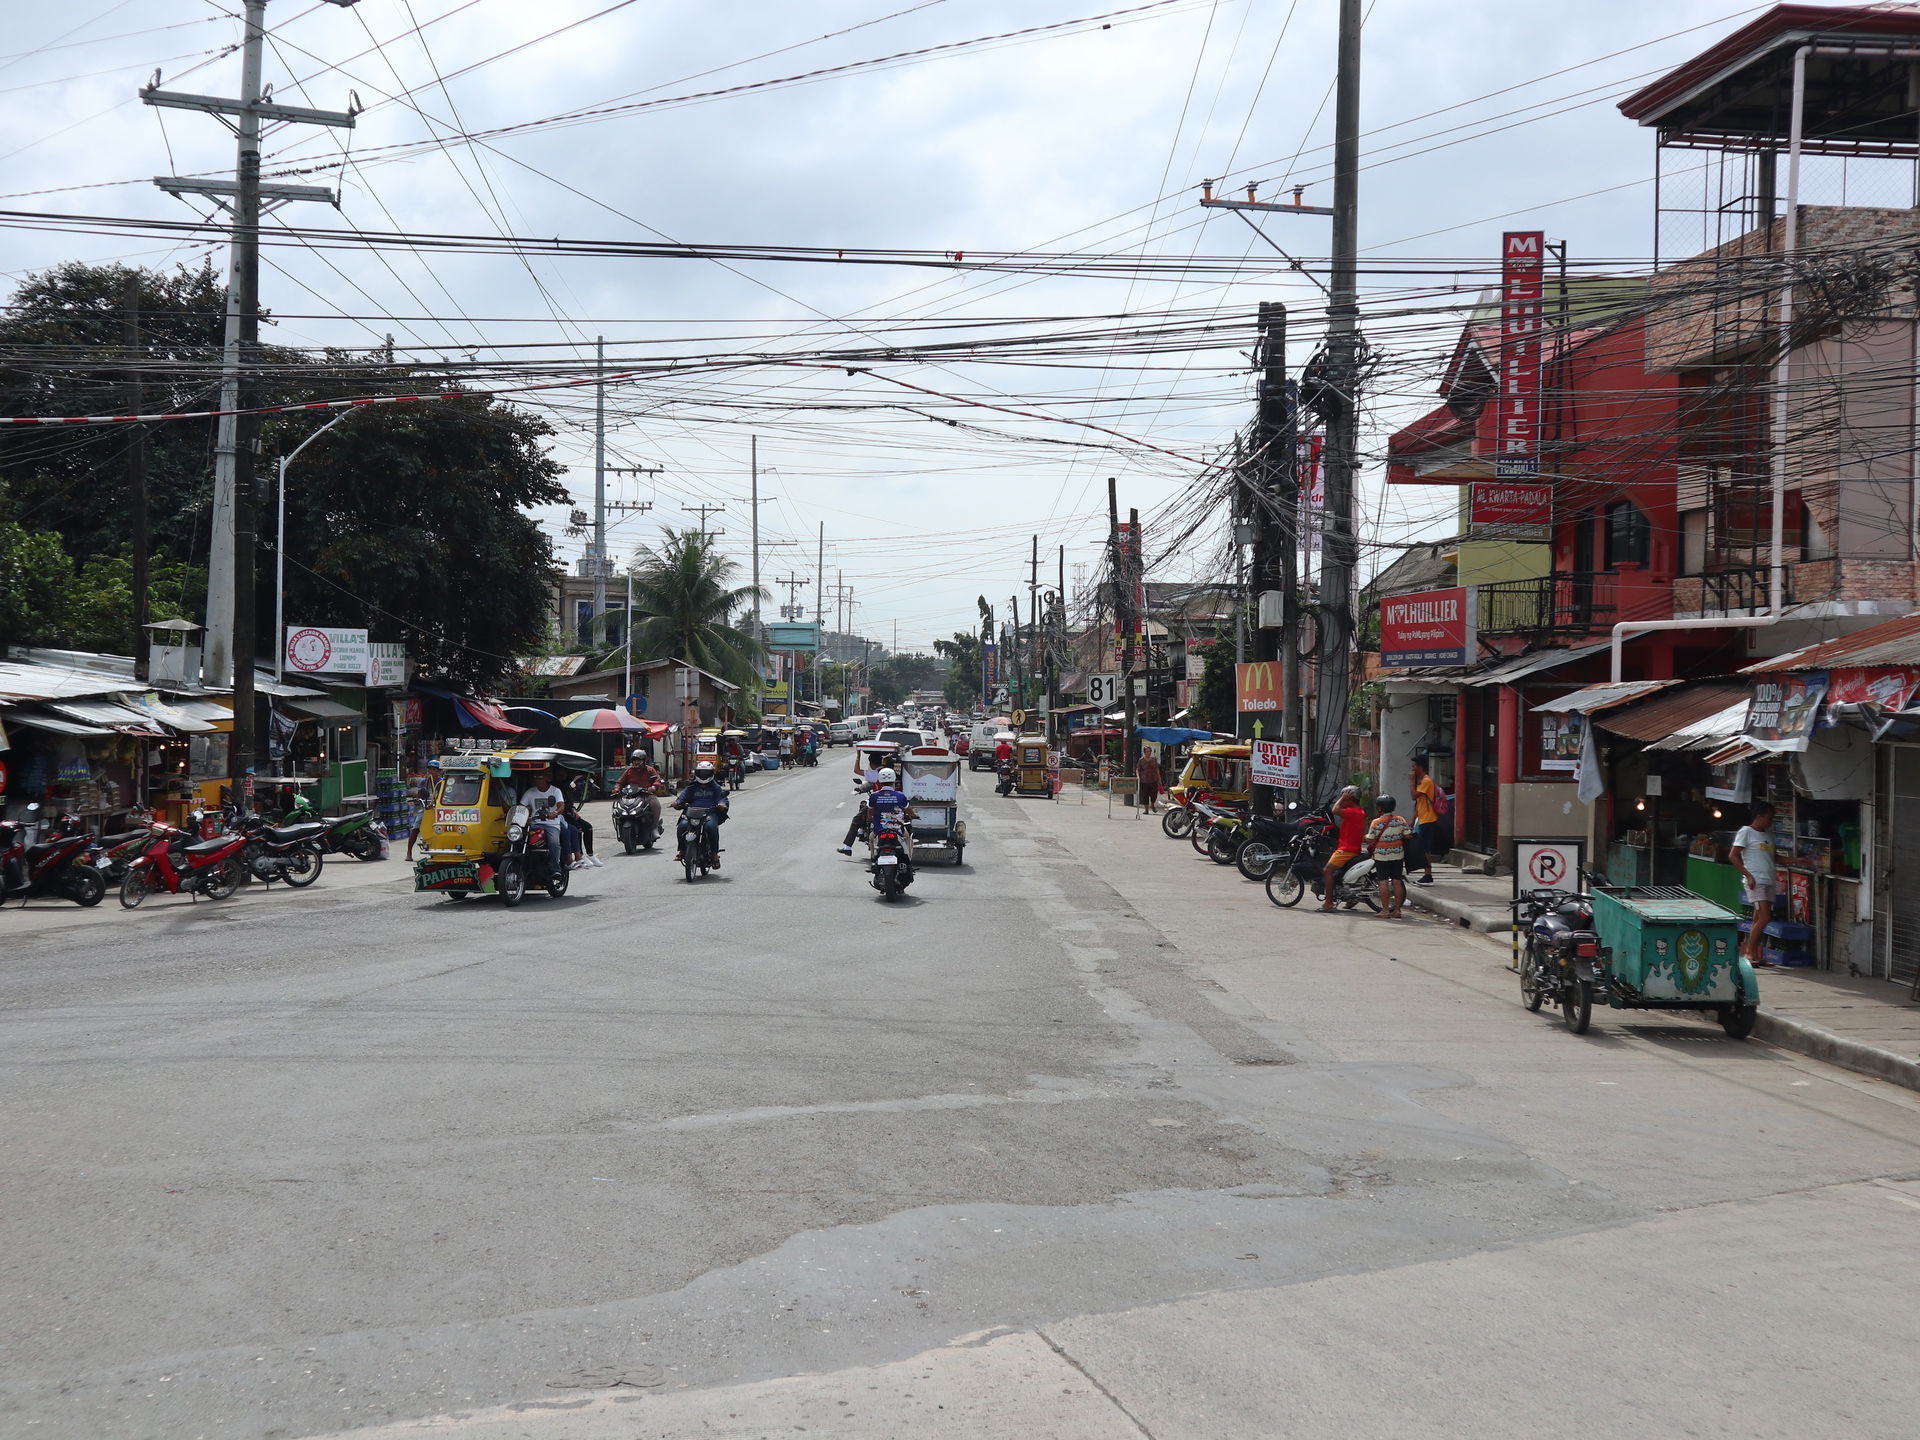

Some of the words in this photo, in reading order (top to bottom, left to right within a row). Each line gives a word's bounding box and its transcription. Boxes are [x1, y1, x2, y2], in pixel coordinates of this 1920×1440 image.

[328, 633, 366, 643] VILLA'S
[369, 643, 405, 658] VILLA'S
[1090, 677, 1114, 701] 81
[1756, 683, 1783, 702] 100%
[1242, 698, 1277, 711] Toledo
[1257, 742, 1274, 754] LOT
[1276, 744, 1297, 757] FOR
[1261, 753, 1290, 768] SALE
[439, 810, 478, 821] Joshua
[421, 867, 473, 887] PANTER
